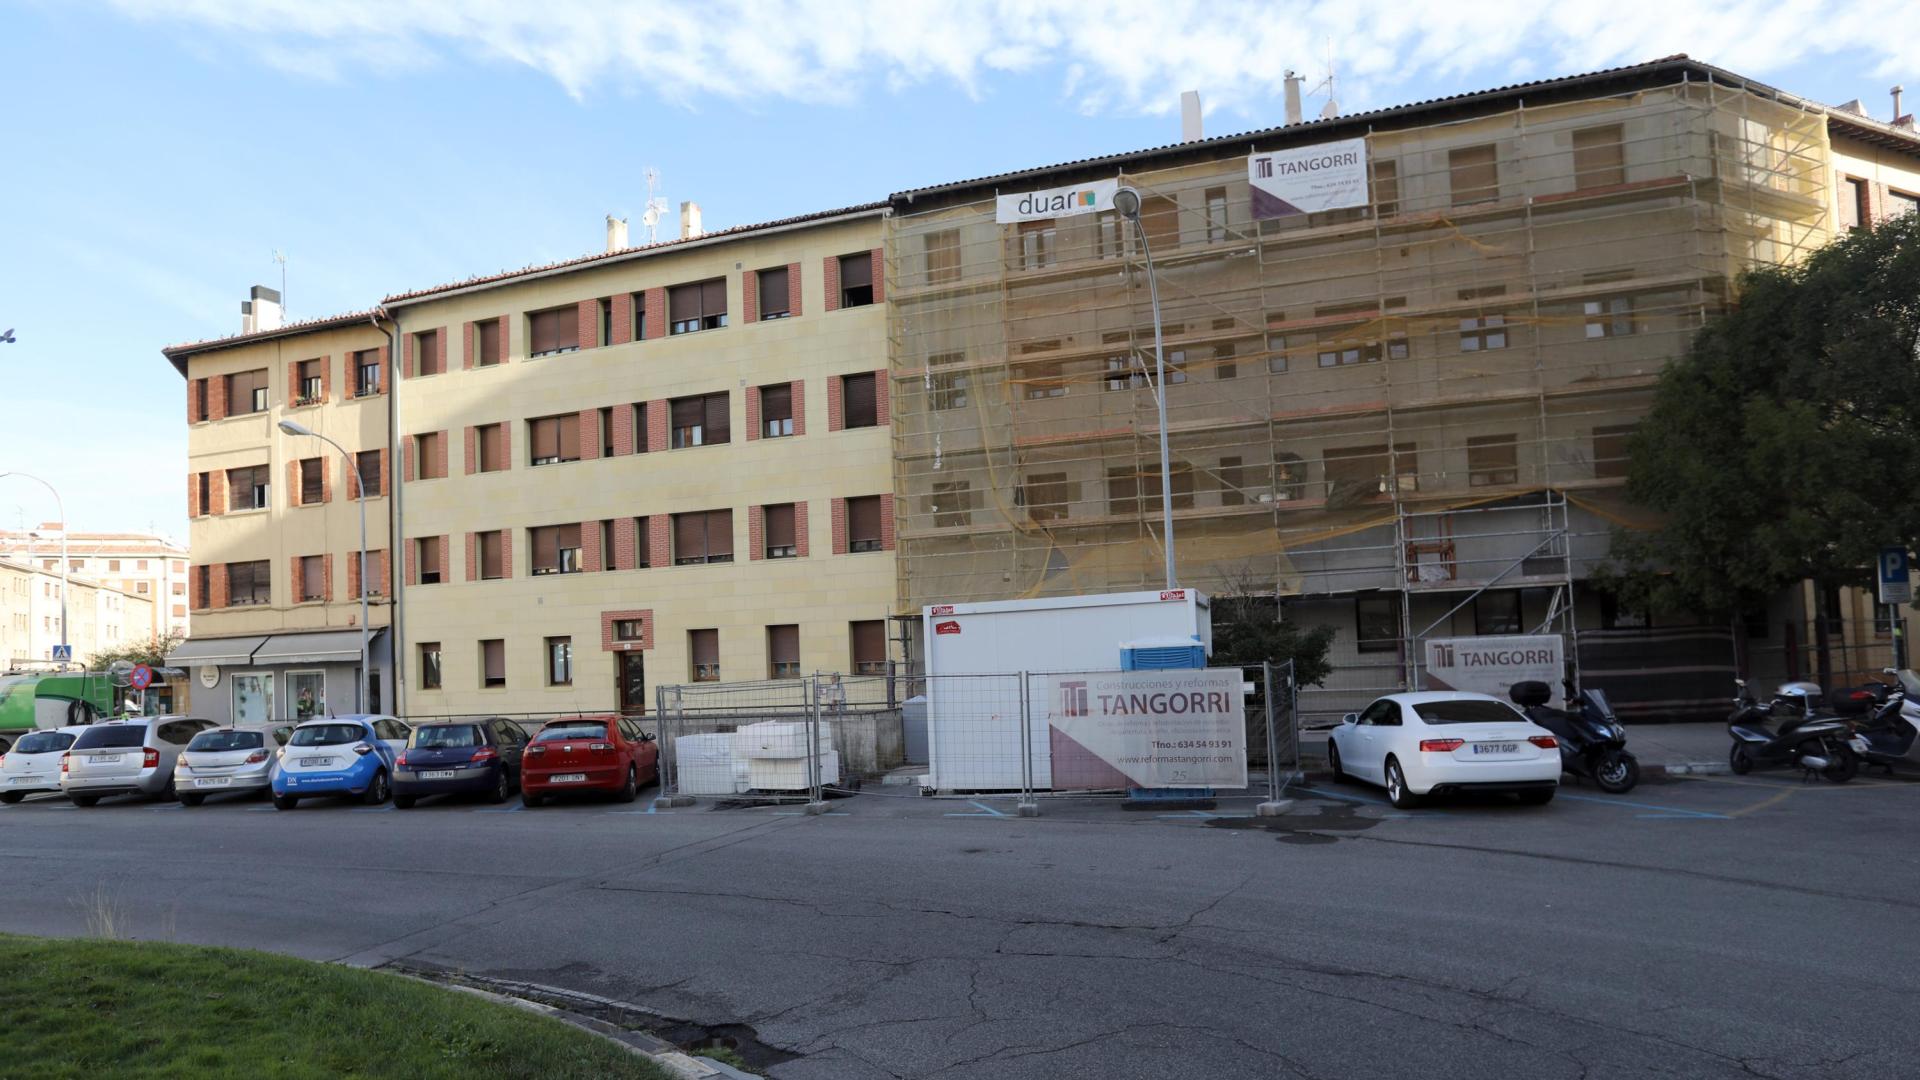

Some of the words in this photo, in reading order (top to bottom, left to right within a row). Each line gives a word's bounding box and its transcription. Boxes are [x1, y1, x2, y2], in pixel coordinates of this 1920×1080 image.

[1278, 152, 1358, 175] TANGORRI
[1019, 192, 1076, 215] duar
[1886, 553, 1901, 578] P
[1460, 650, 1554, 666] TANGORRI
[1097, 680, 1173, 690] Construcciones
[1176, 681, 1183, 690] y
[1184, 678, 1230, 688] reformas
[1097, 692, 1230, 715] TANGORRI
[1178, 741, 1194, 749] 634
[1196, 741, 1207, 749] 54
[1209, 741, 1220, 749] 93
[1479, 743, 1500, 753] 3677
[1117, 755, 1233, 765] www.reformastangorri.com
